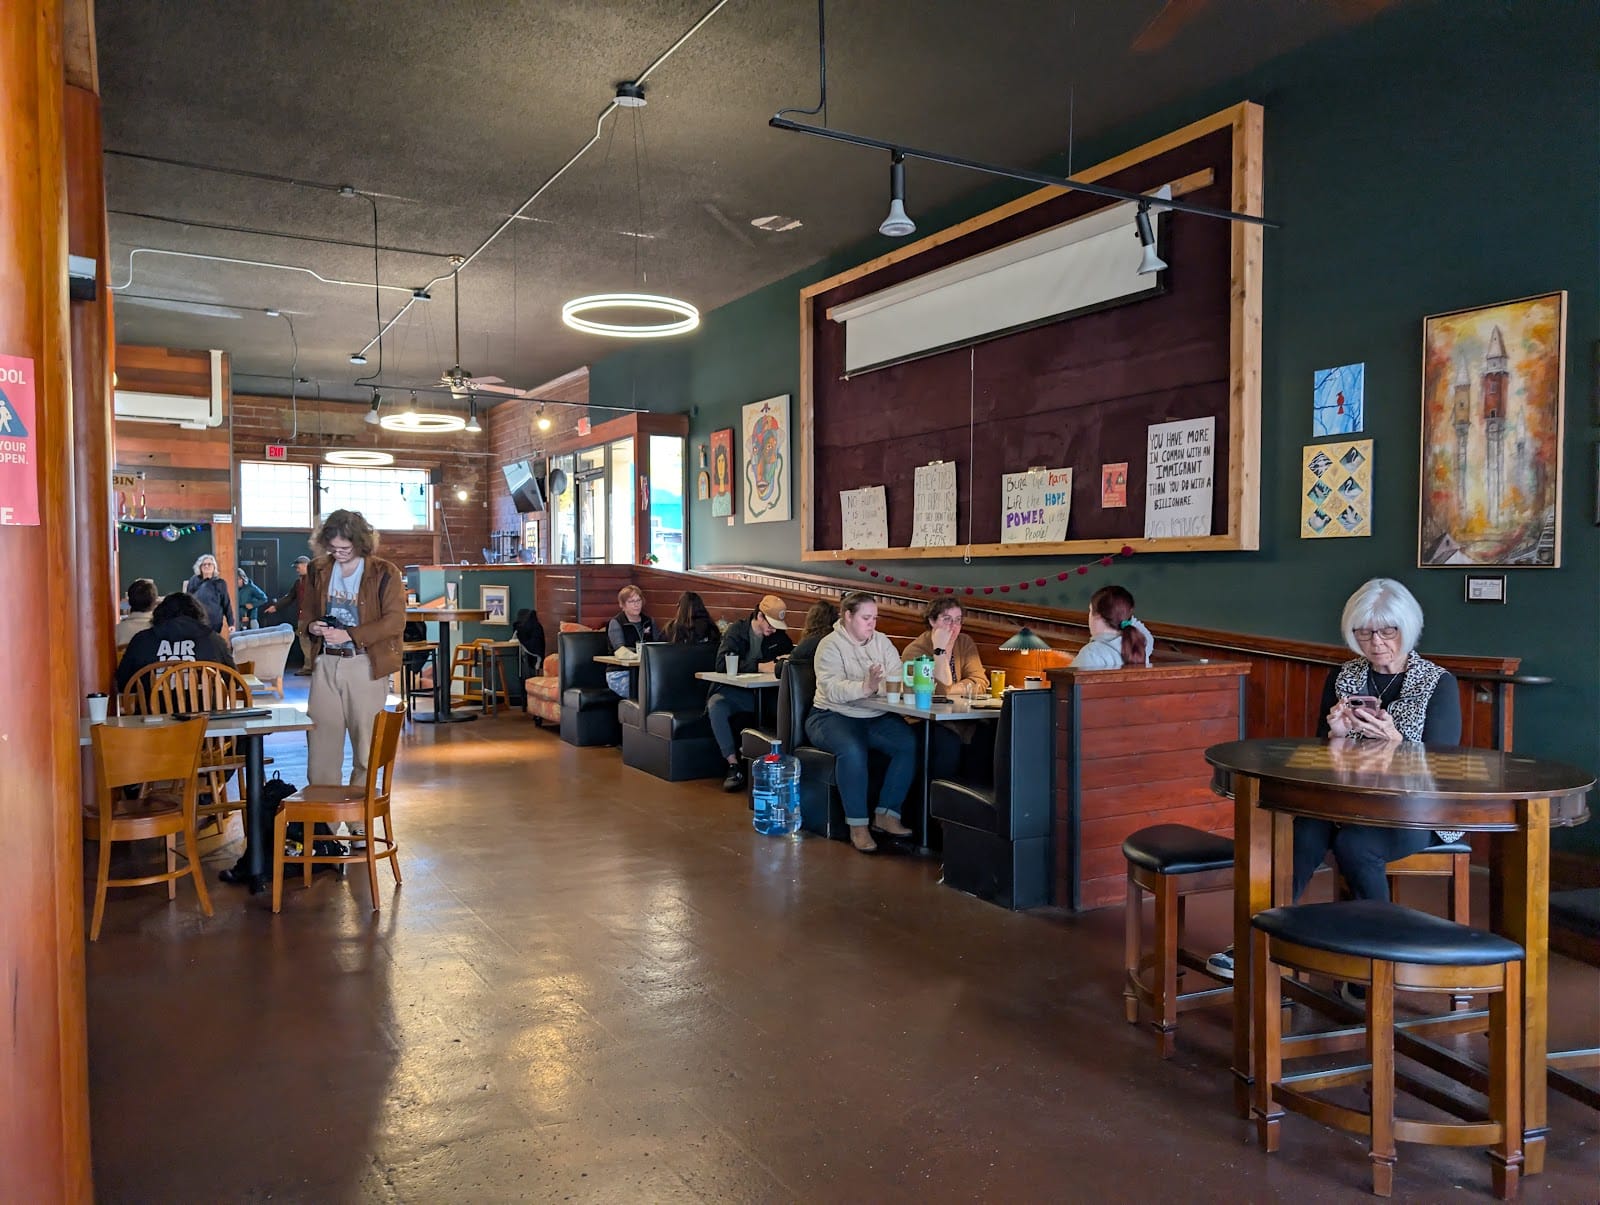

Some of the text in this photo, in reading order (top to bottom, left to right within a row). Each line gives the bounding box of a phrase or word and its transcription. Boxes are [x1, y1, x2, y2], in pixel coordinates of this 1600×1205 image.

[1149, 428, 1209, 450] YOU HAVE MORE
[269, 446, 284, 457] EXIT
[1149, 445, 1211, 464] IN COMMON WITH AN
[1156, 460, 1203, 479] IMMIGRANT
[1148, 477, 1212, 496] THAN YOU DO WITH A
[1007, 494, 1022, 511] Lift
[1044, 491, 1066, 507] HOPE
[1006, 508, 1046, 529] POWER
[157, 640, 196, 656] AIR
